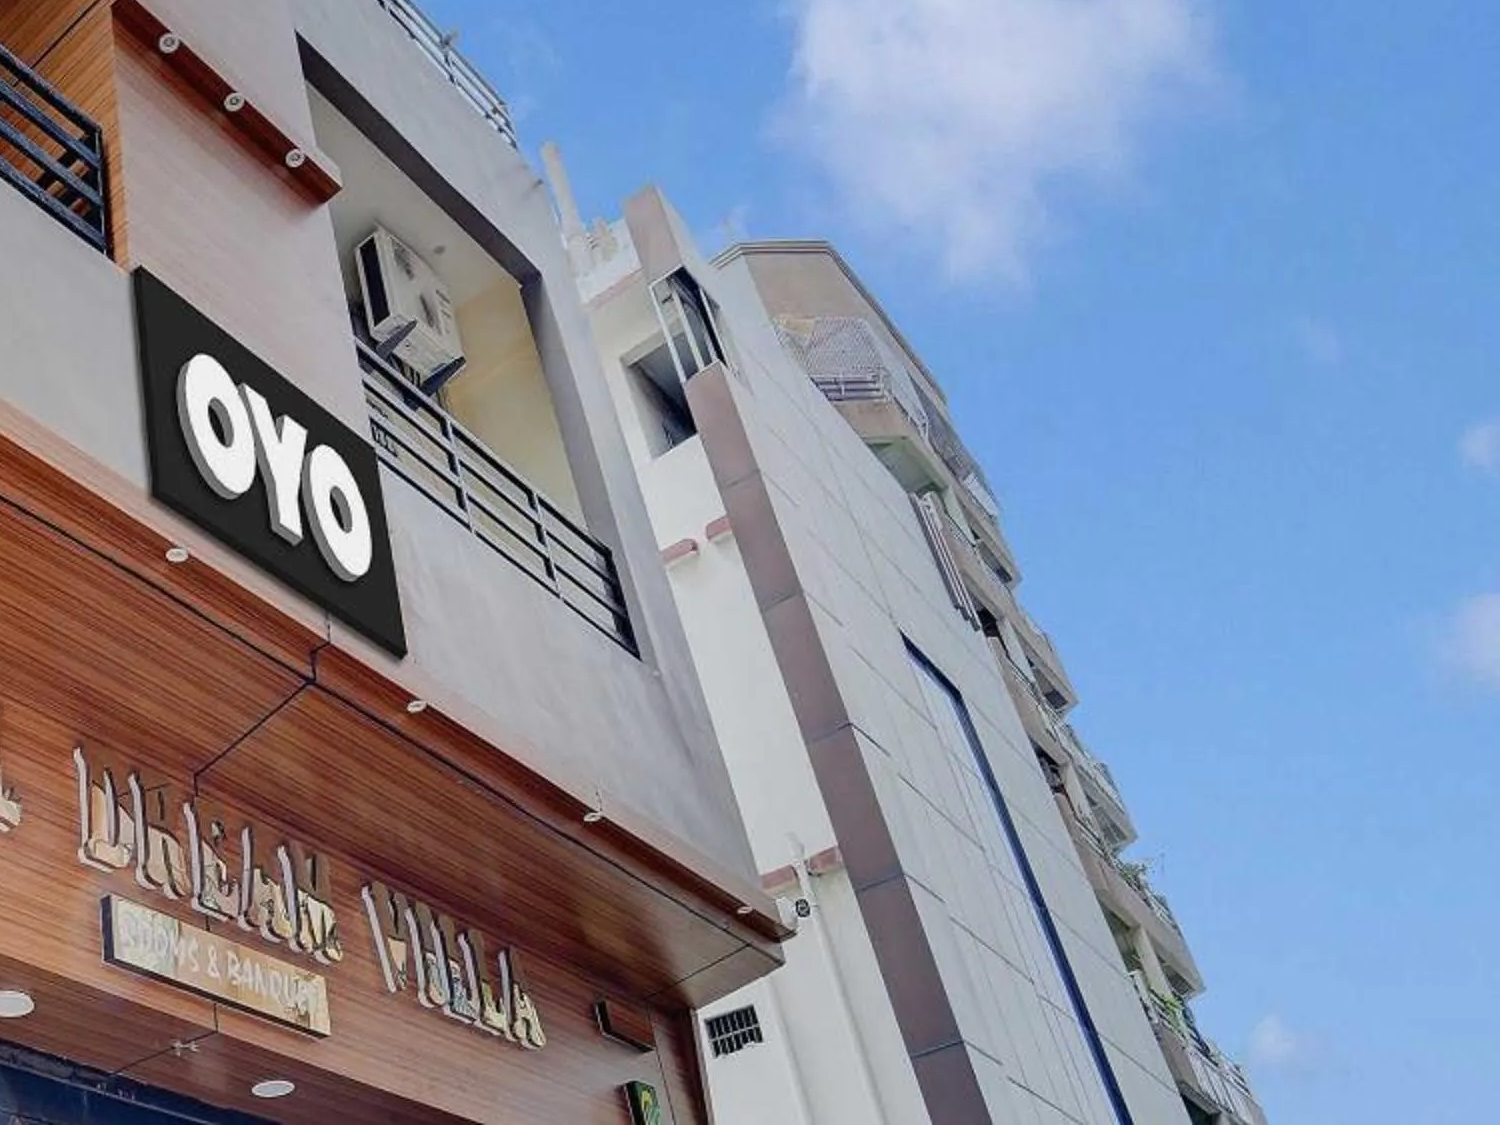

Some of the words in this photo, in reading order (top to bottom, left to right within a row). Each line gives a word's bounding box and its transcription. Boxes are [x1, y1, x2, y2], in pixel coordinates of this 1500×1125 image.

[176, 354, 373, 582] OYO
[72, 740, 344, 965] DREAM
[361, 879, 547, 1051] VILLA
